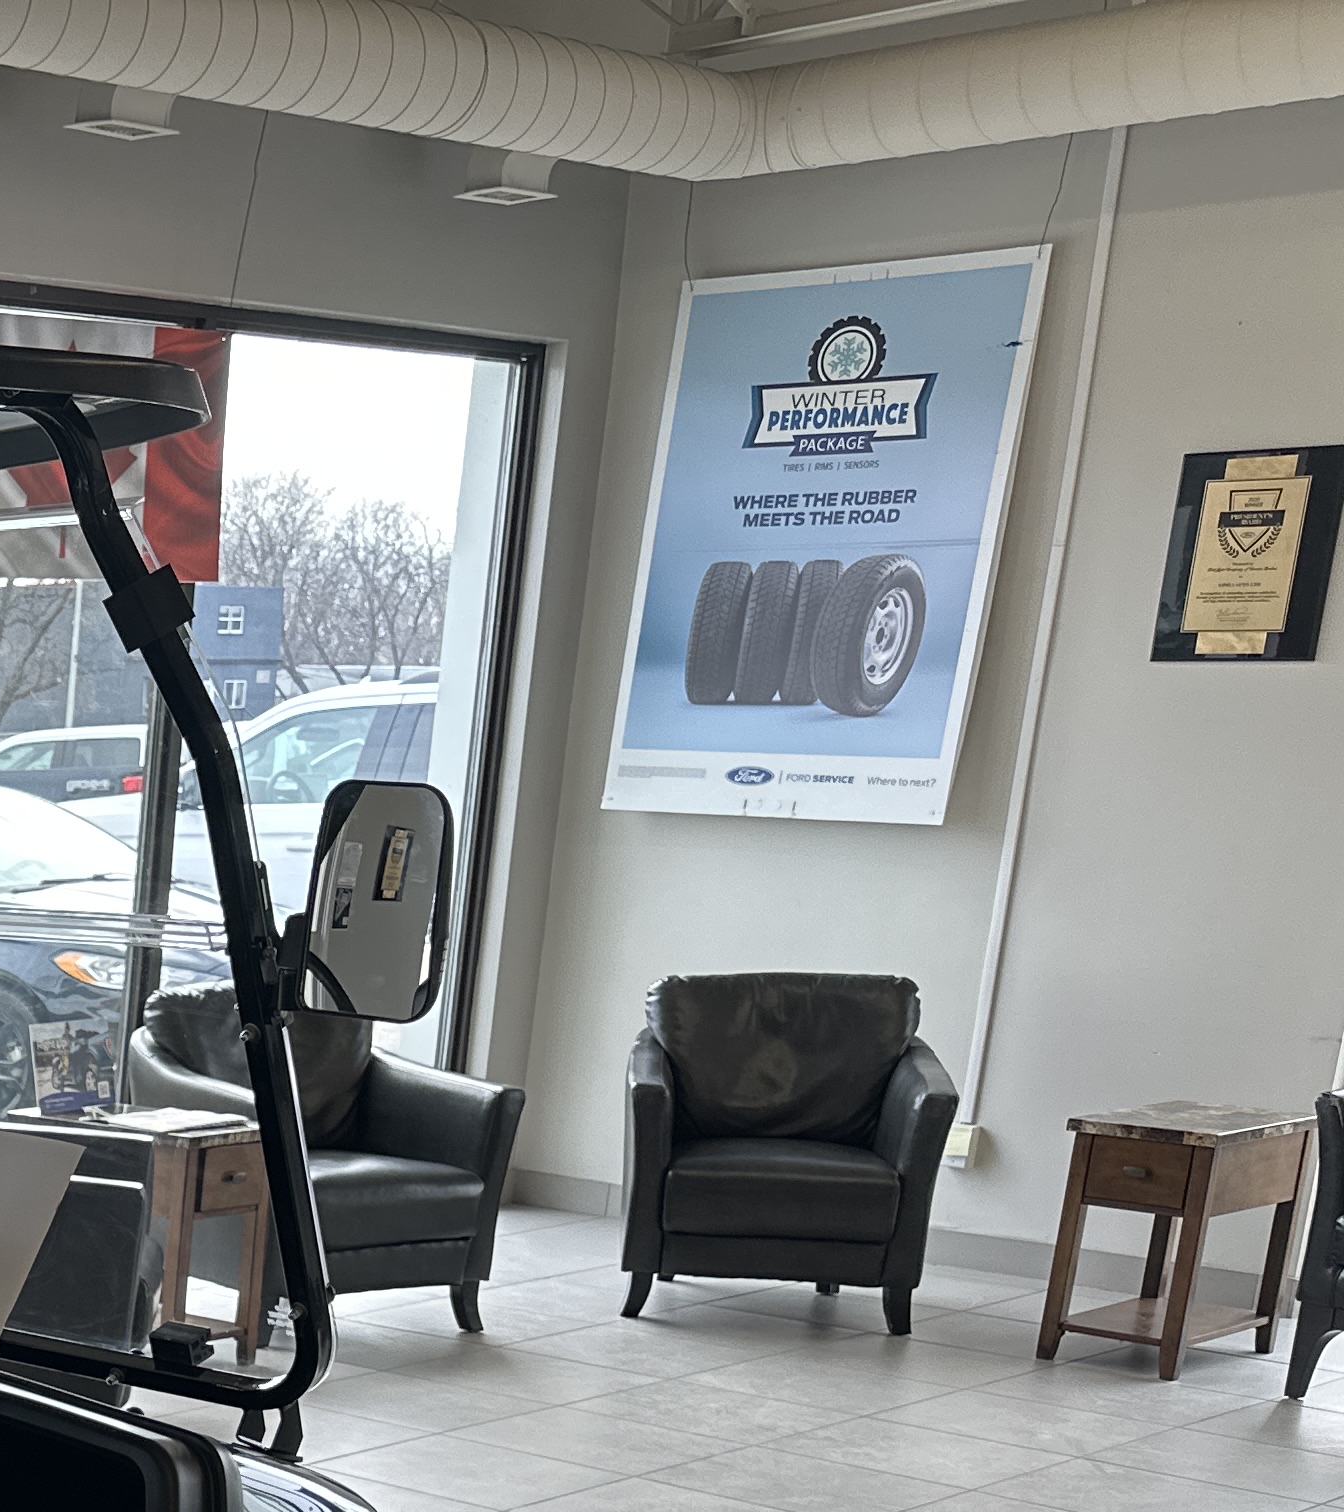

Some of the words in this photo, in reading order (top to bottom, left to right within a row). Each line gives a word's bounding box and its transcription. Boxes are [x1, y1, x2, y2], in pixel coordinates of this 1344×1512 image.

[792, 389, 887, 409] WINTER
[767, 402, 910, 431] PERFORMANCE
[799, 436, 866, 452] PACKAGE
[783, 463, 805, 472] TIRES
[814, 462, 833, 471] RIMS
[844, 460, 880, 470] SENSORS
[733, 494, 798, 510] WHERE
[802, 492, 837, 507] THE
[841, 489, 918, 507] RUBBER
[742, 512, 806, 528] MEETS
[809, 510, 846, 525] THE
[848, 509, 901, 525] ROAD
[734, 769, 765, 784] Ford
[786, 773, 811, 783] FORD
[812, 774, 855, 785] SERVICE
[867, 776, 897, 787] Where
[898, 778, 909, 787] to
[910, 778, 937, 788] next?
